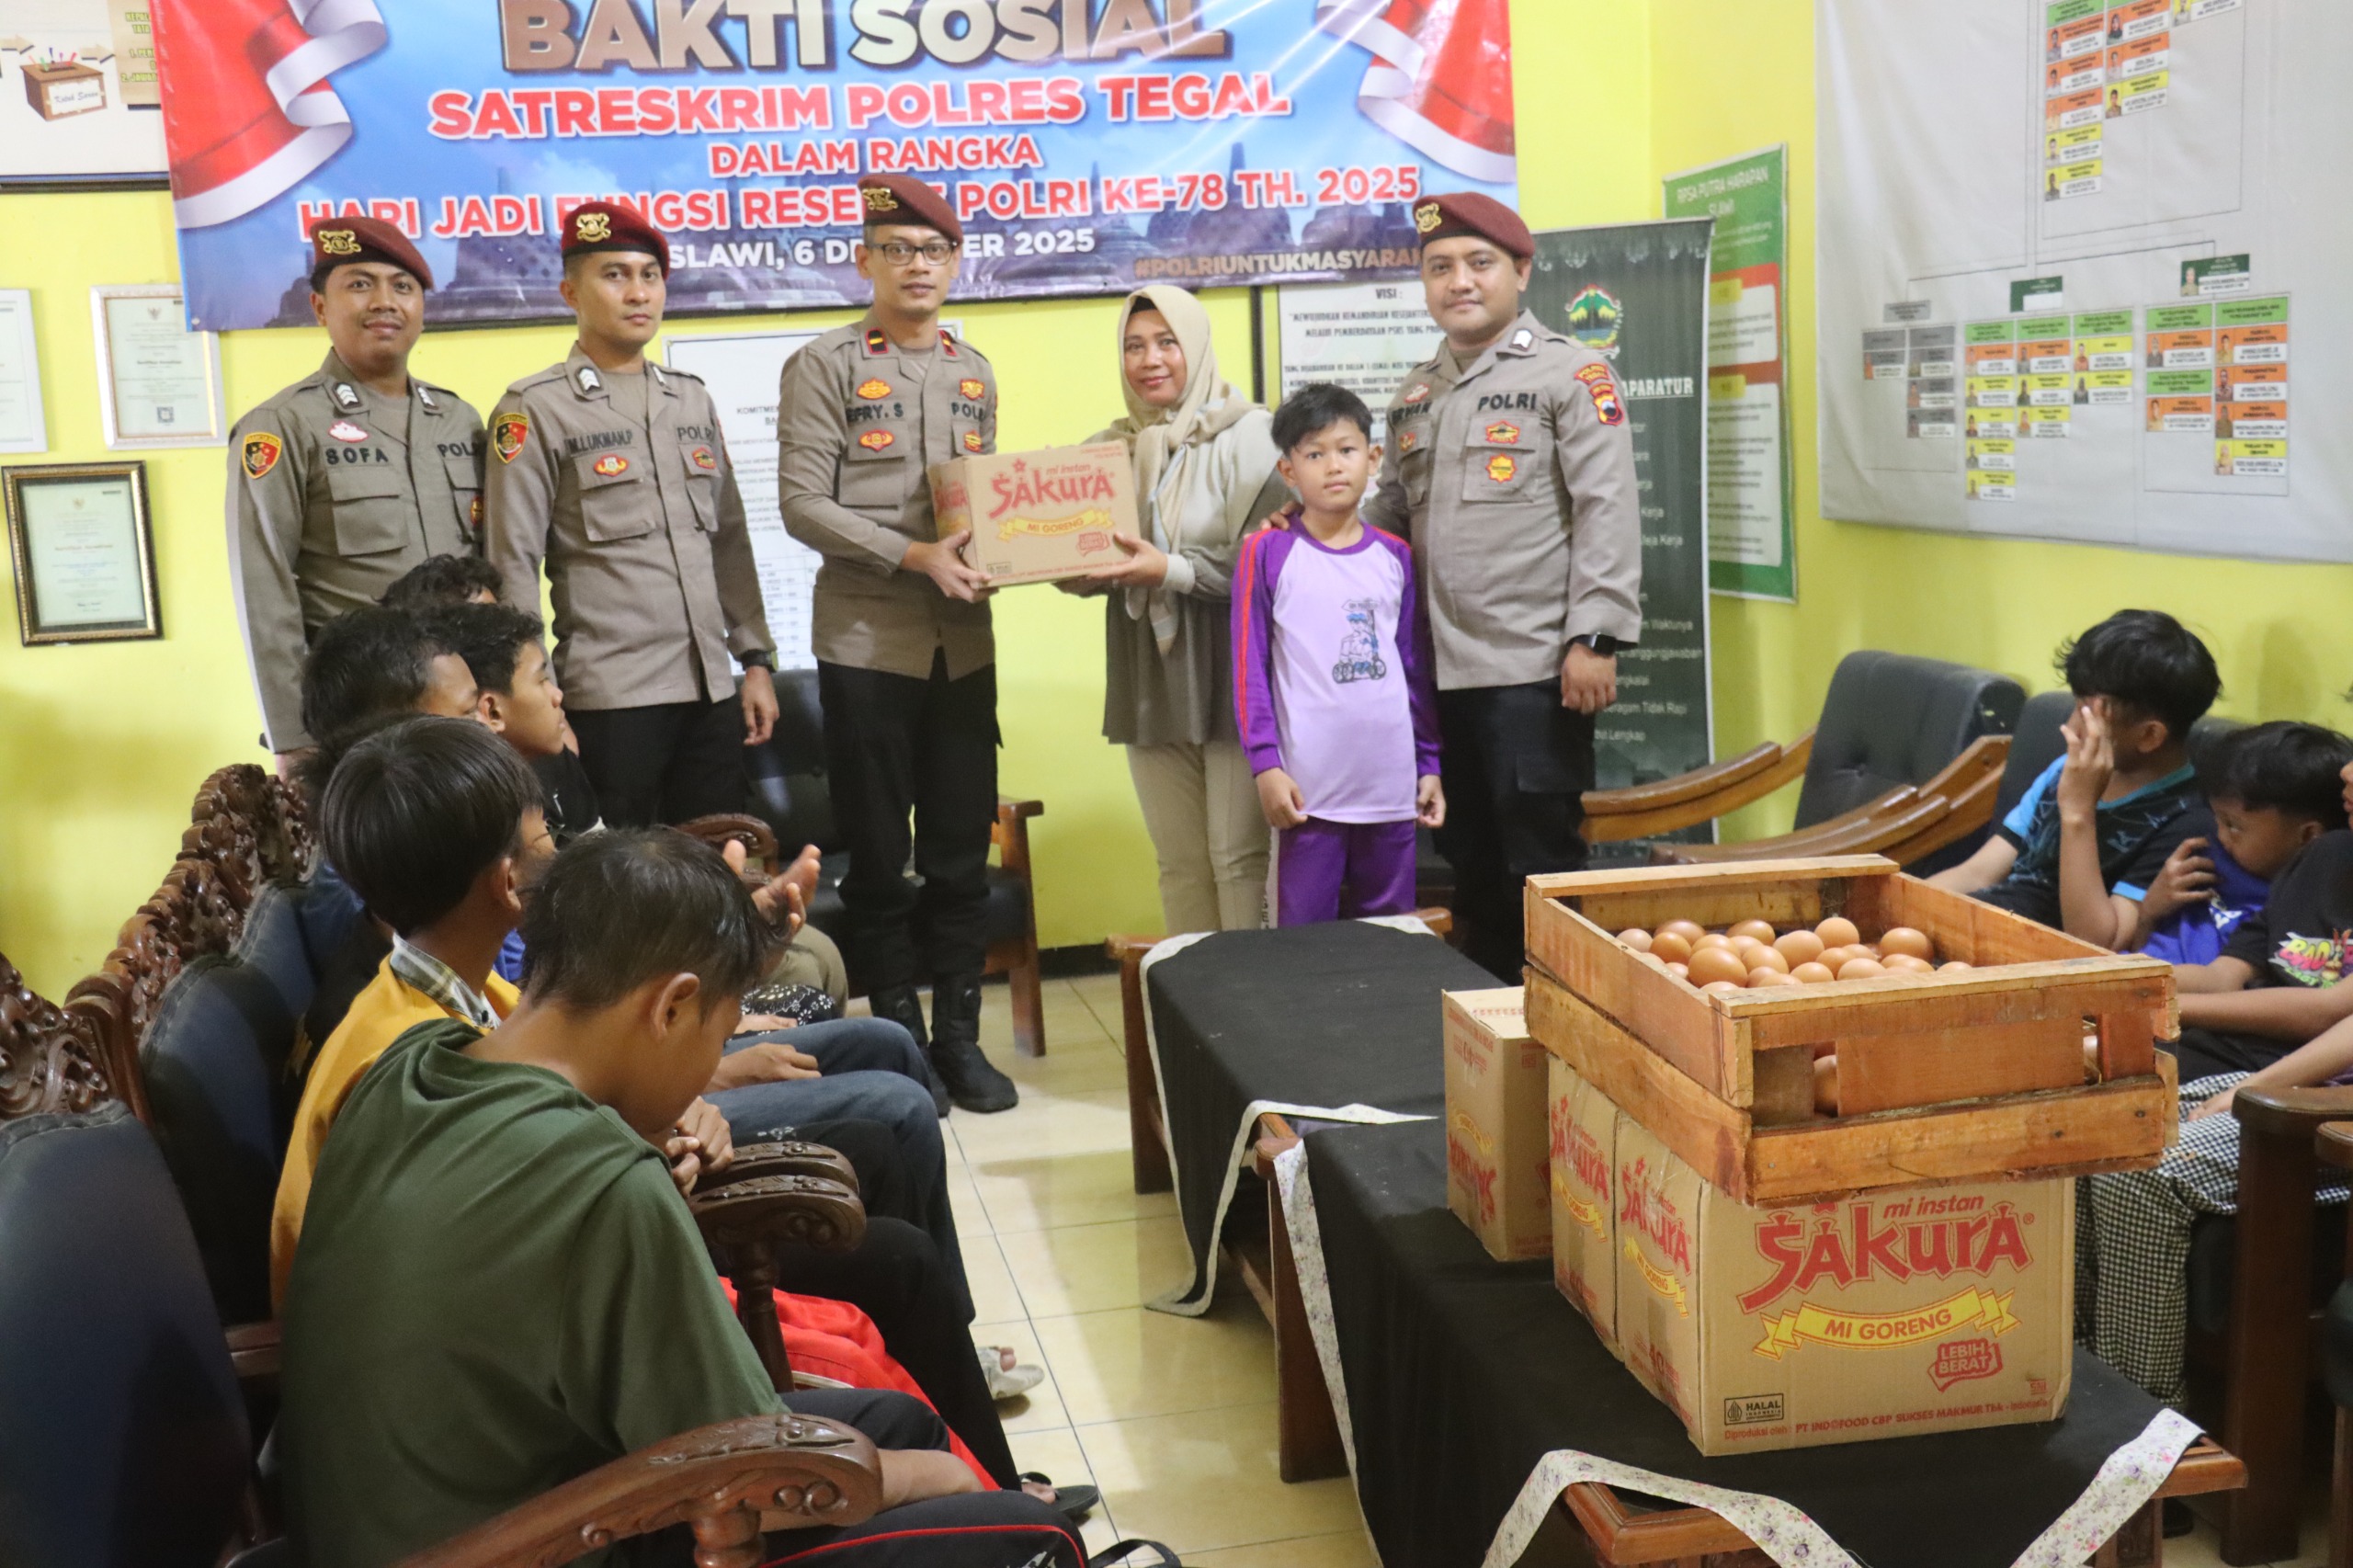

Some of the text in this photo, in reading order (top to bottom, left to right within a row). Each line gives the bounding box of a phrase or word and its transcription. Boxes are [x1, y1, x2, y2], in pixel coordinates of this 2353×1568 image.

[503, 0, 1229, 72] BAKTI SOSIAL
[429, 73, 1292, 139] SATRESKRIM POLRES TEGAL
[708, 134, 1044, 178] DALAM RANGKA
[431, 194, 545, 239] JADI
[957, 179, 1092, 221] POLRI
[1103, 173, 1227, 215] KE-78
[1237, 169, 1307, 210] TH.
[1317, 164, 1422, 206] 2025
[794, 240, 815, 267] 6
[1013, 227, 1096, 257] 2025
[1375, 288, 1396, 301] VISI
[1477, 392, 1538, 412] POLRI
[325, 447, 390, 465] SOFA
[1041, 517, 1085, 534] GORENG
[2279, 938, 2330, 971] BAD
[1883, 1194, 1985, 1219] mi instan
[1824, 1308, 1953, 1341] MI GORENG
[1938, 1356, 1989, 1374] BERAT
[1940, 1343, 1985, 1360] LEBIH
[1745, 1400, 1781, 1412] HALAL
[1724, 1426, 1768, 1441] Diproduksi
[1795, 1423, 1808, 1434] PT
[1871, 1415, 1893, 1425] CBP
[1895, 1410, 1934, 1423] SUKSES
[1936, 1405, 1984, 1418] MAKMUR
